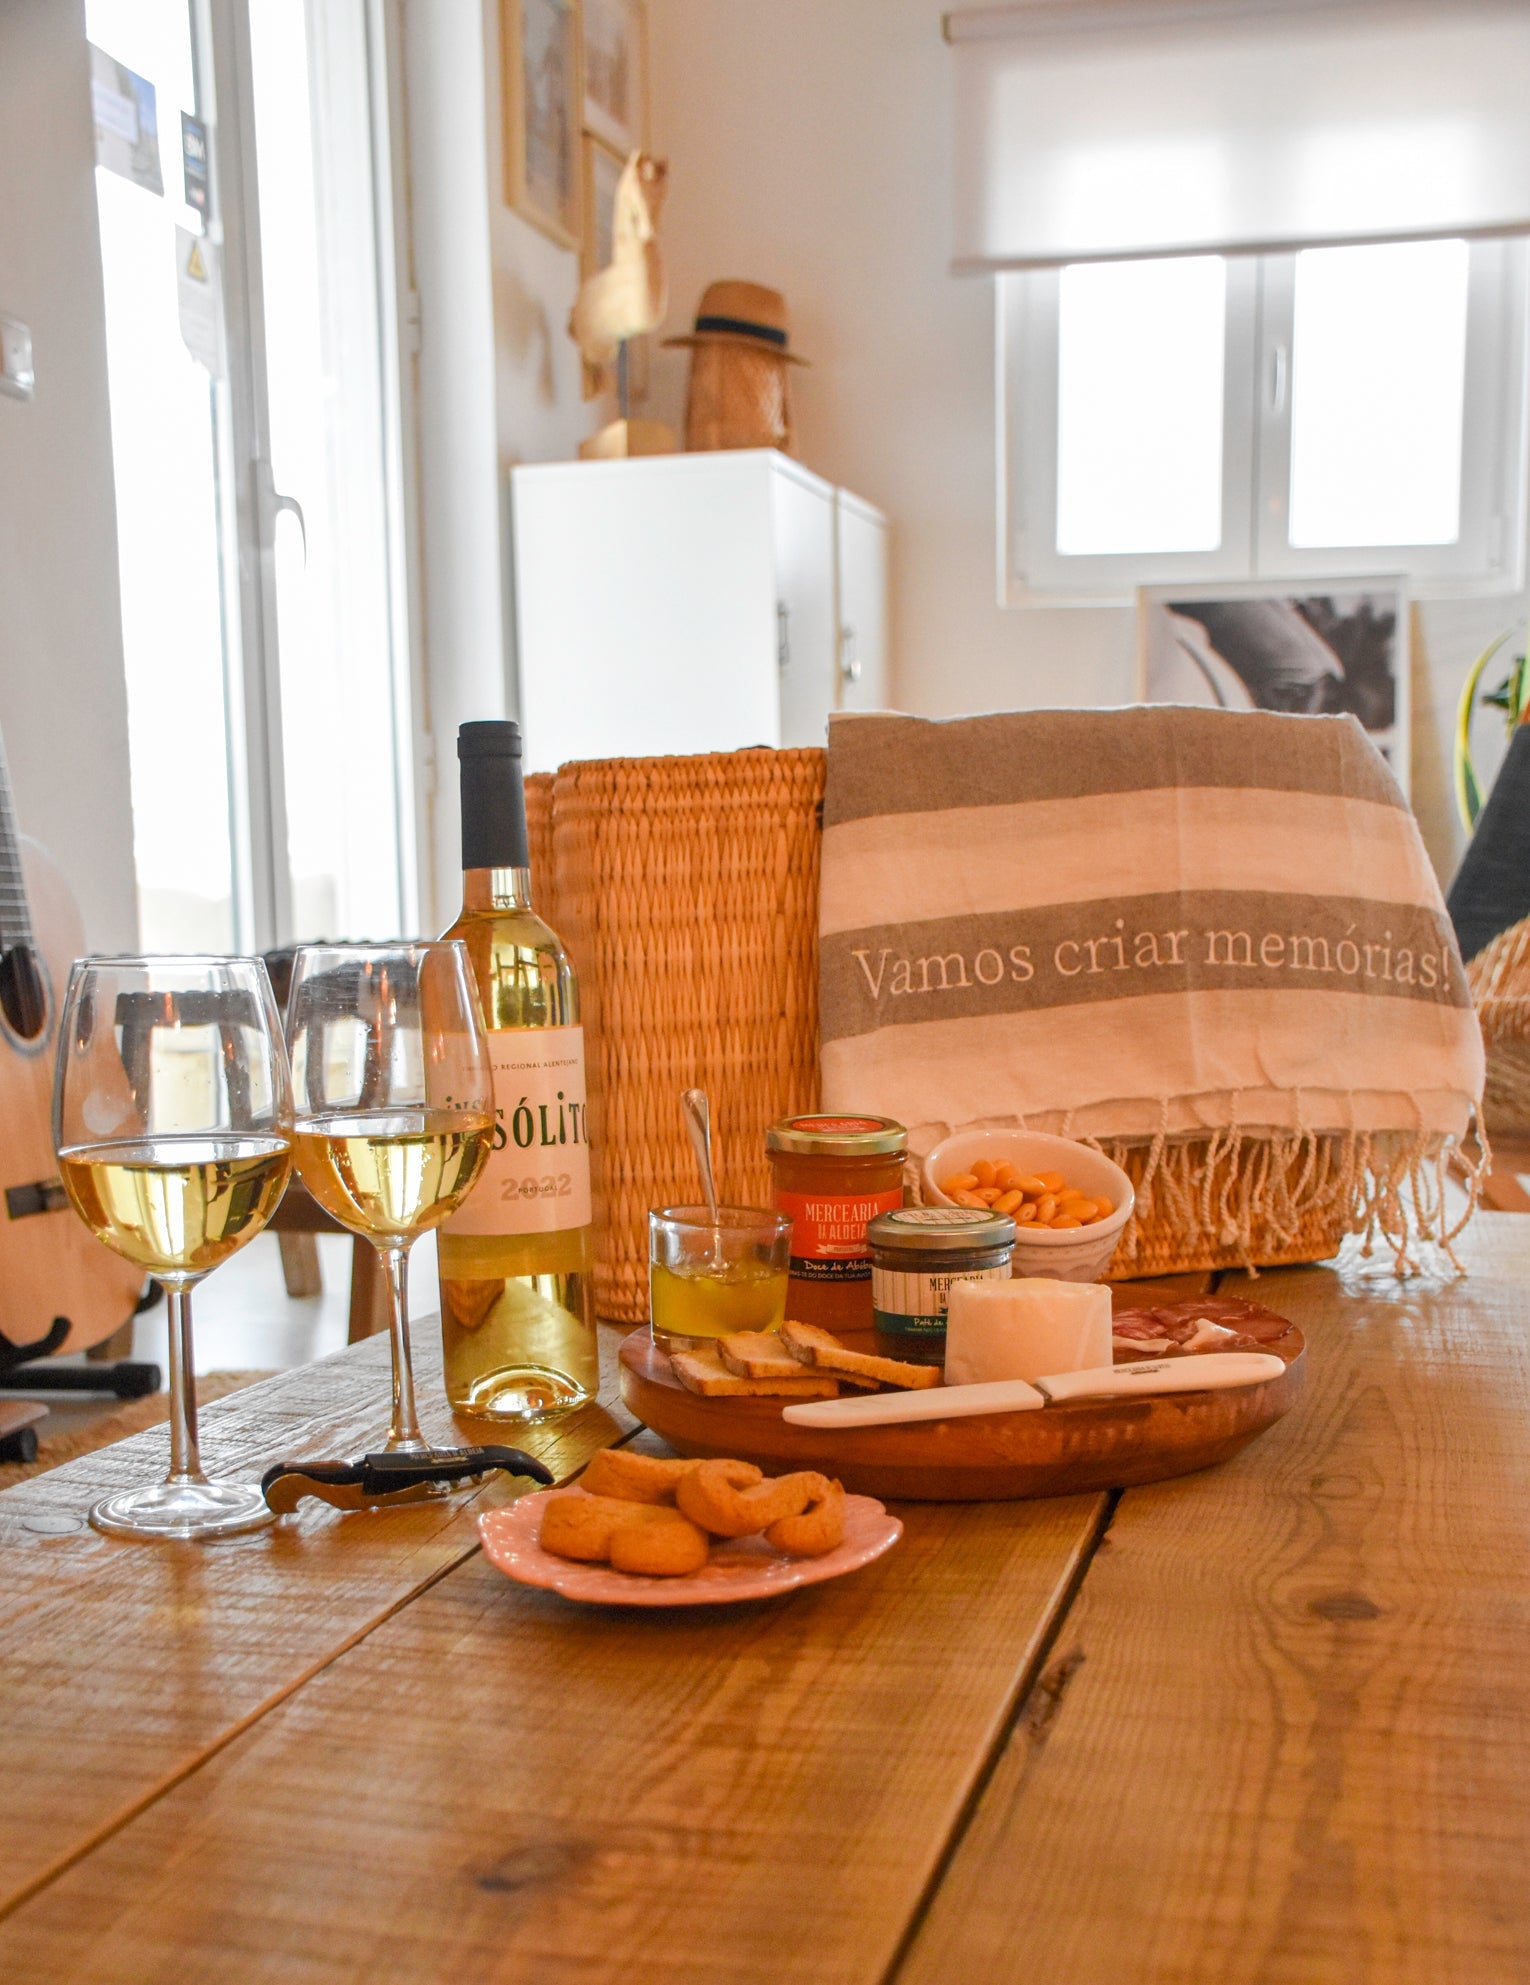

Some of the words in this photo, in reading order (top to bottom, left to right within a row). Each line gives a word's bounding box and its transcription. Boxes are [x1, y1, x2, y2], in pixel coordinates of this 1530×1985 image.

[851, 945, 1034, 1000] Vamos
[1054, 918, 1189, 977] criar
[1203, 923, 1450, 992] memórias!
[501, 1061, 540, 1070] REGIONAL
[501, 1173, 572, 1201] 2022
[805, 1202, 879, 1222] MERCEARIA
[804, 1260, 829, 1270] Doce
